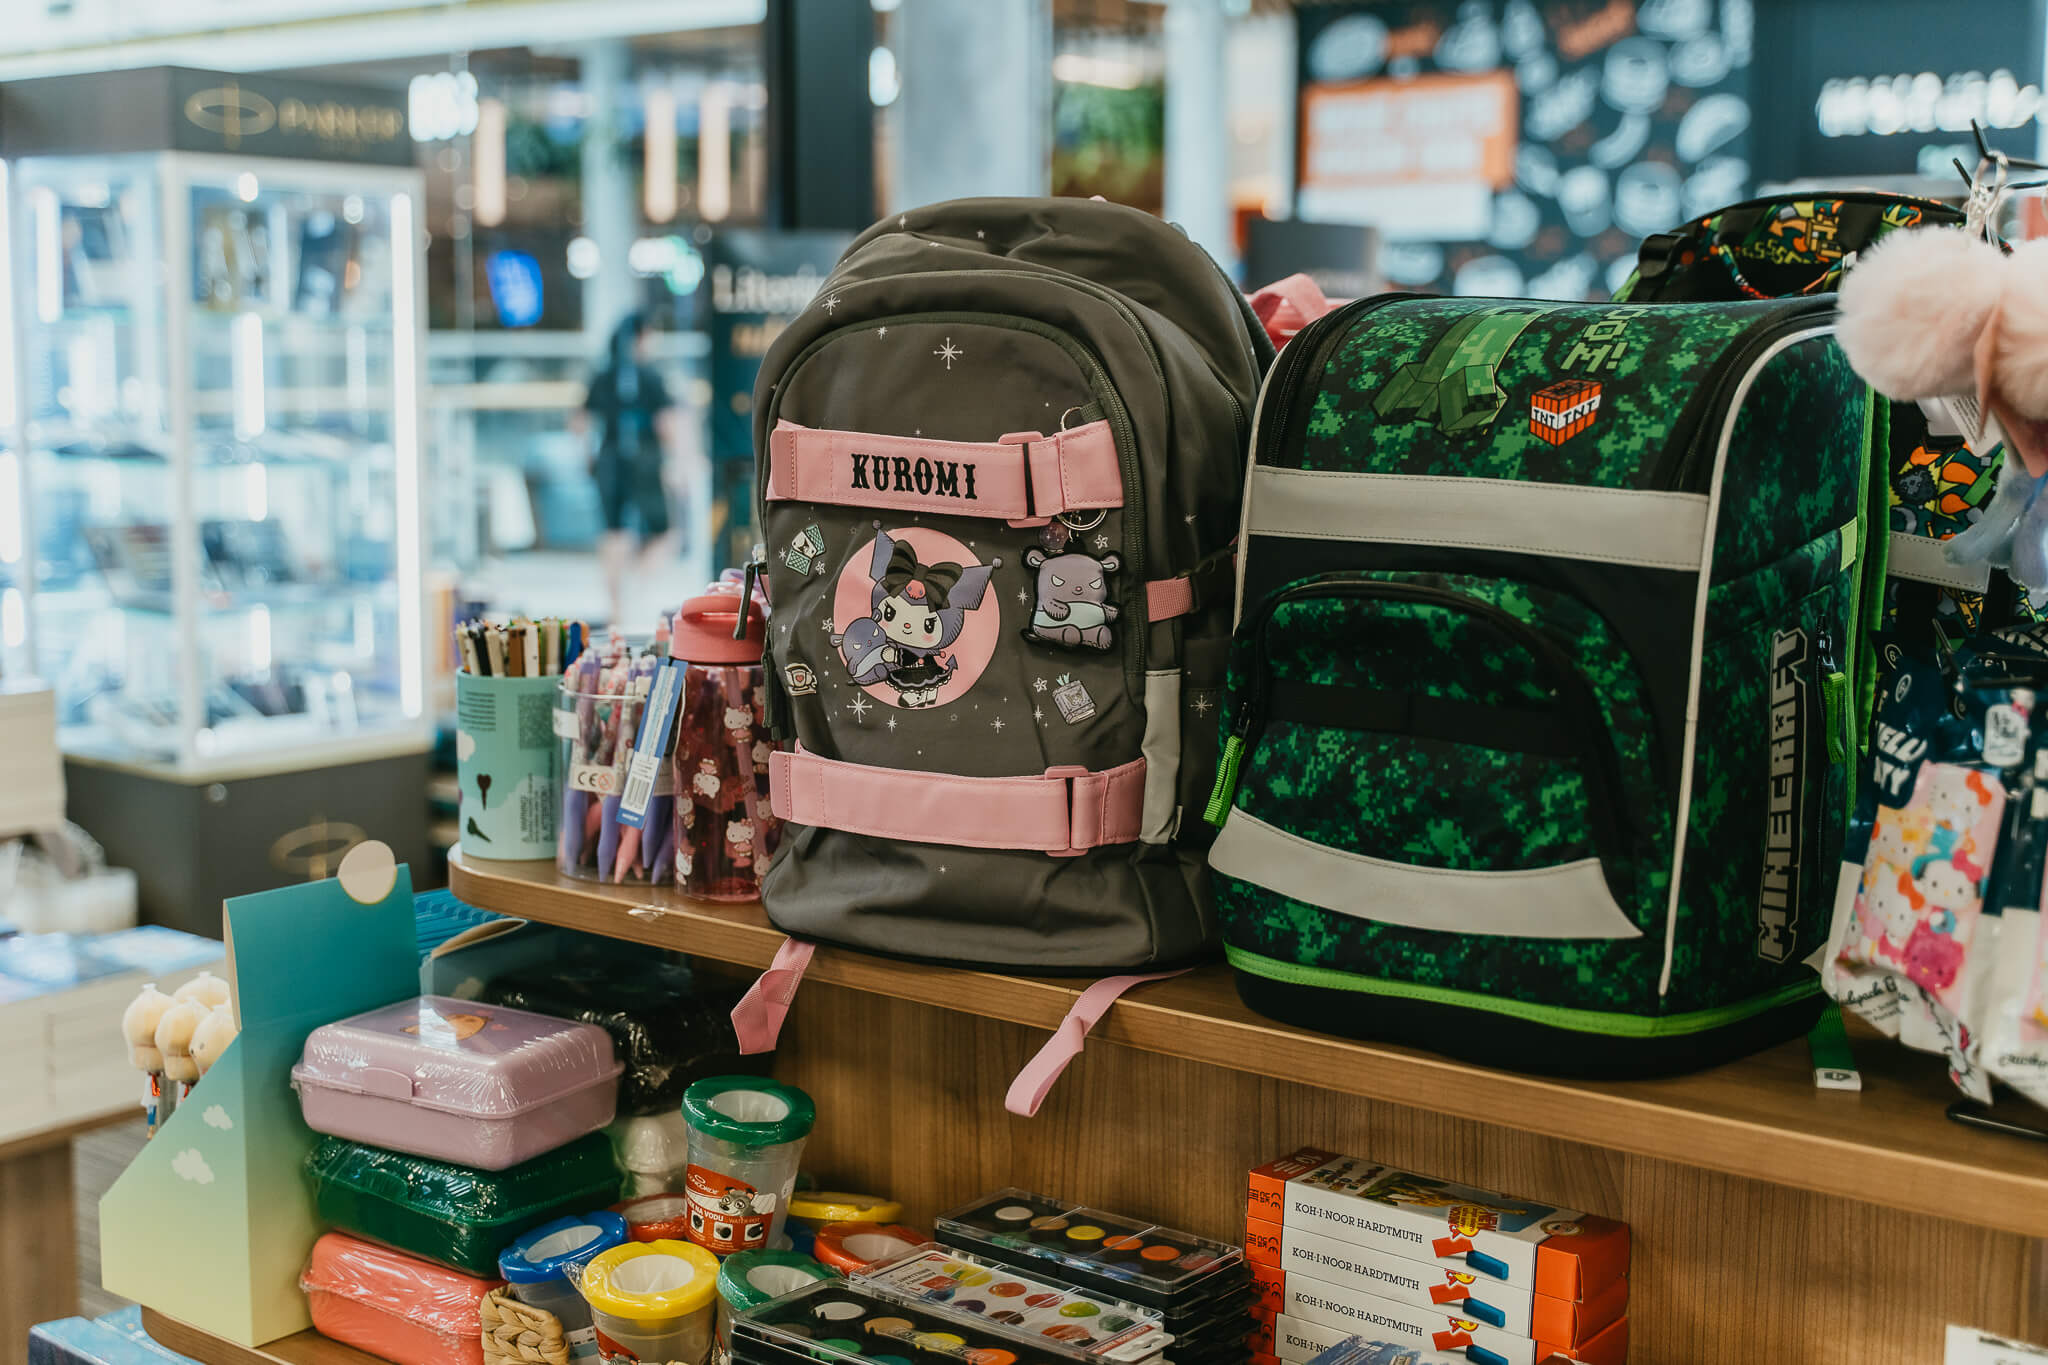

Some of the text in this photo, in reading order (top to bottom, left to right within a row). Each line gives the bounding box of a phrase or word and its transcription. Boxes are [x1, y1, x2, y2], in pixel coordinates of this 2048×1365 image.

[1533, 408, 1556, 426] TNT
[1563, 399, 1596, 426] TNT
[851, 453, 977, 500] KUROMI
[1760, 630, 1801, 961] MINECRAFT
[704, 1210, 724, 1222] VODU
[1357, 1218, 1423, 1244] HARDTMUTH
[1354, 1264, 1420, 1290] HARDTMUTH
[1357, 1308, 1423, 1337] HARDTMUTH
